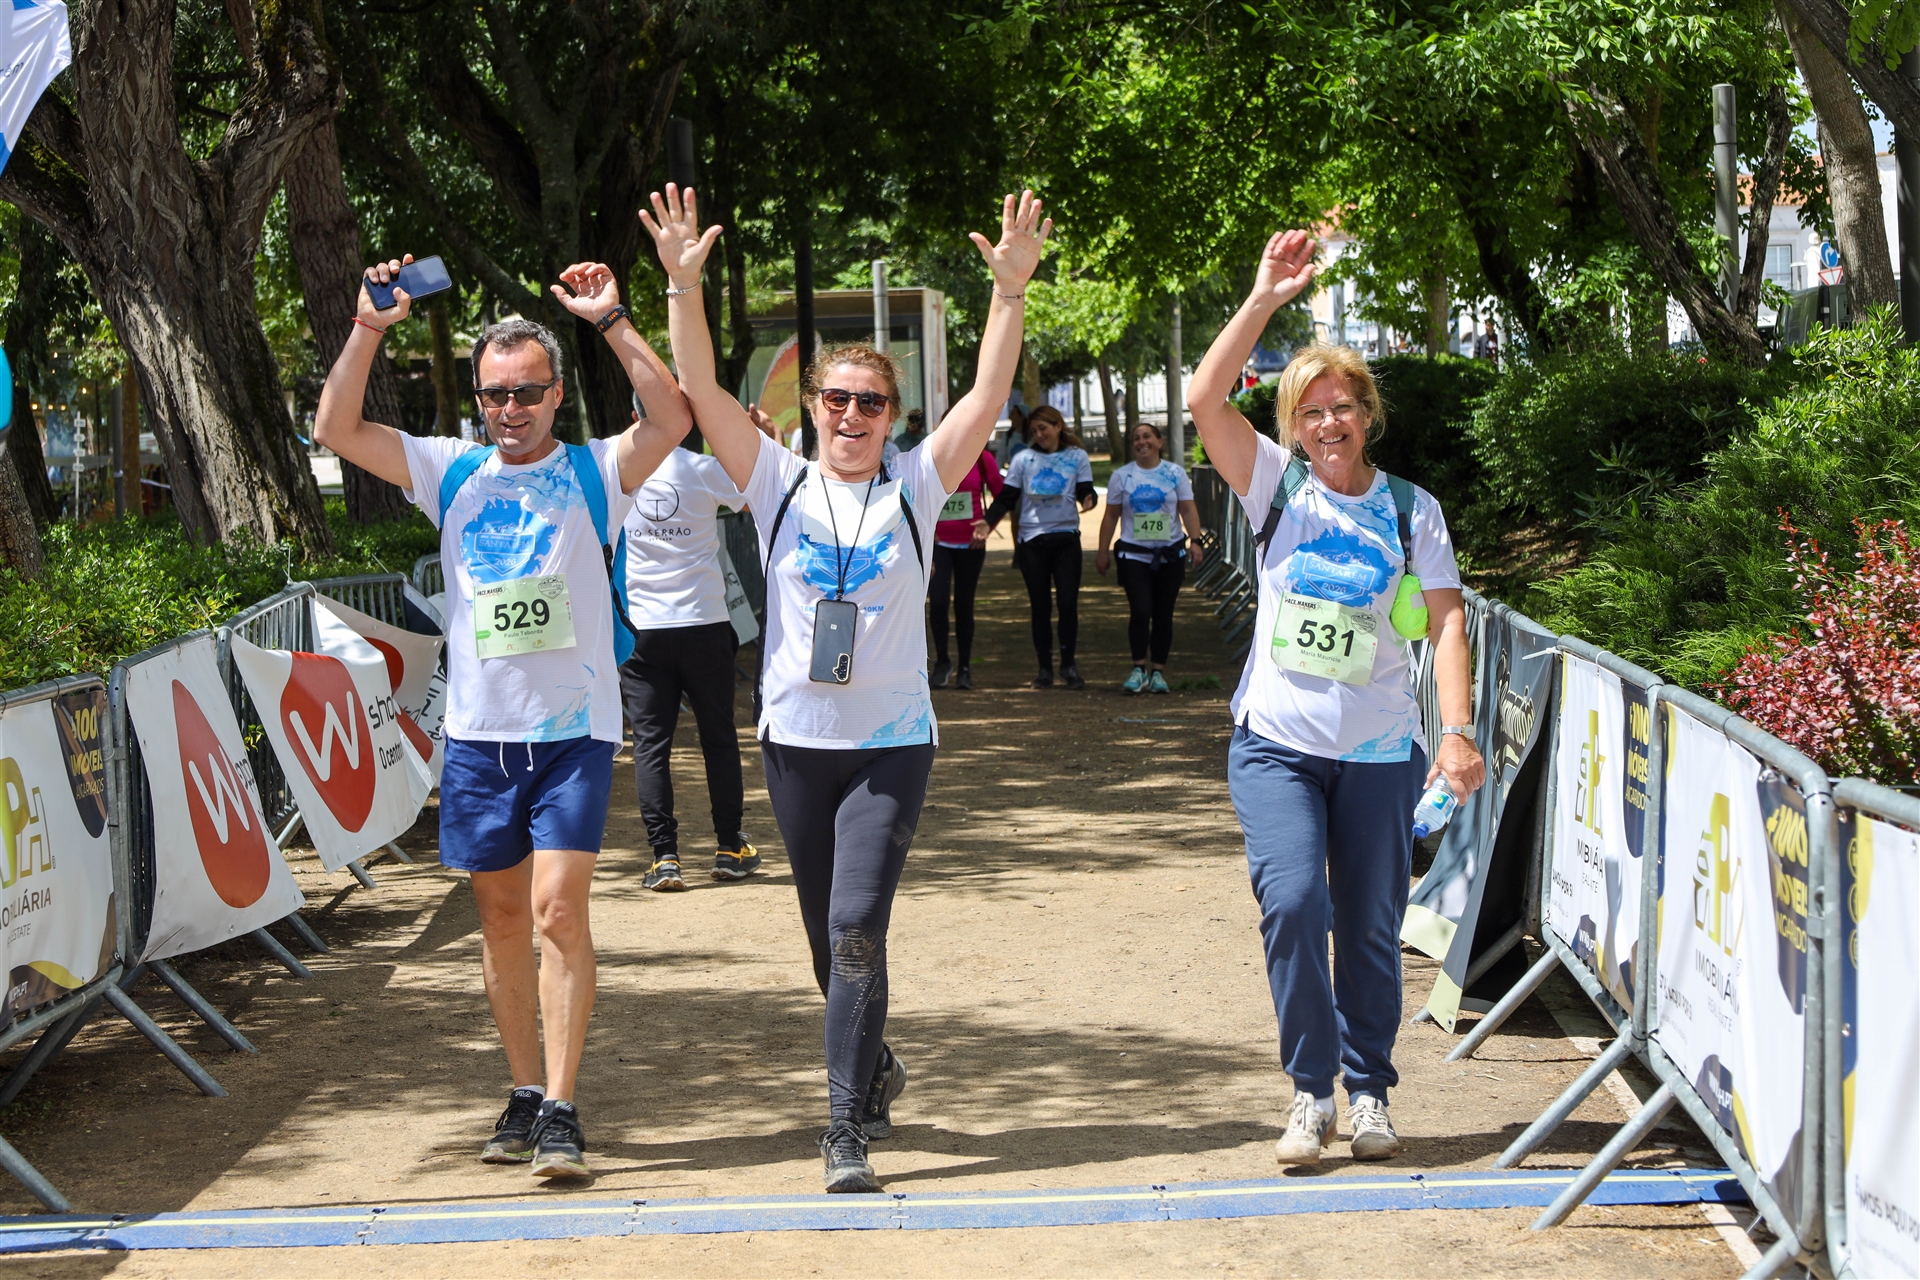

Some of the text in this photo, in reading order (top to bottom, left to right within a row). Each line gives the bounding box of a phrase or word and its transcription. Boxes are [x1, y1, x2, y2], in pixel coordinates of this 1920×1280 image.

[1141, 520, 1163, 531] 478
[648, 526, 692, 538] SERRÃO
[494, 557, 517, 566] 2026
[1308, 560, 1368, 582] SANTARÉM
[1322, 581, 1347, 594] 2026
[494, 599, 550, 631] 529
[1297, 620, 1354, 657] 531
[1300, 649, 1315, 657] Maria
[515, 1090, 532, 1098] FILA
[1885, 1201, 1907, 1233] AQUI
